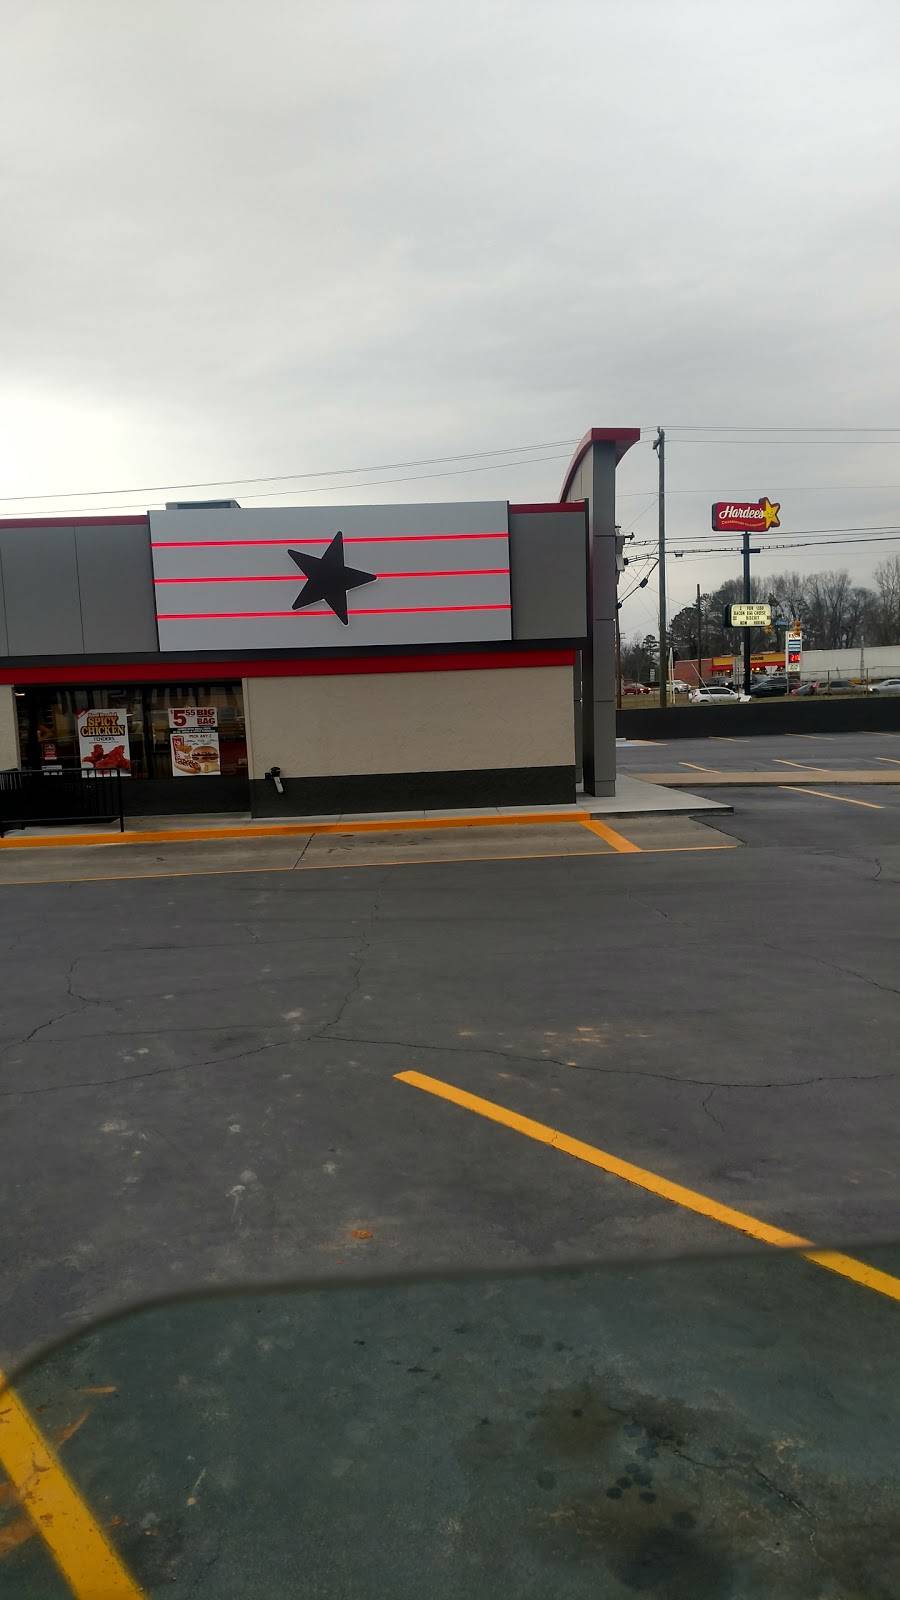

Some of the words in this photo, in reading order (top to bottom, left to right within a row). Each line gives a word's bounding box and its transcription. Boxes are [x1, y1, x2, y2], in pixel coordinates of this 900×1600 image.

[719, 505, 764, 519] Hardee's
[87, 716, 118, 726] SPICY
[196, 717, 215, 725] BAG
[80, 725, 125, 737] CHICKEN
